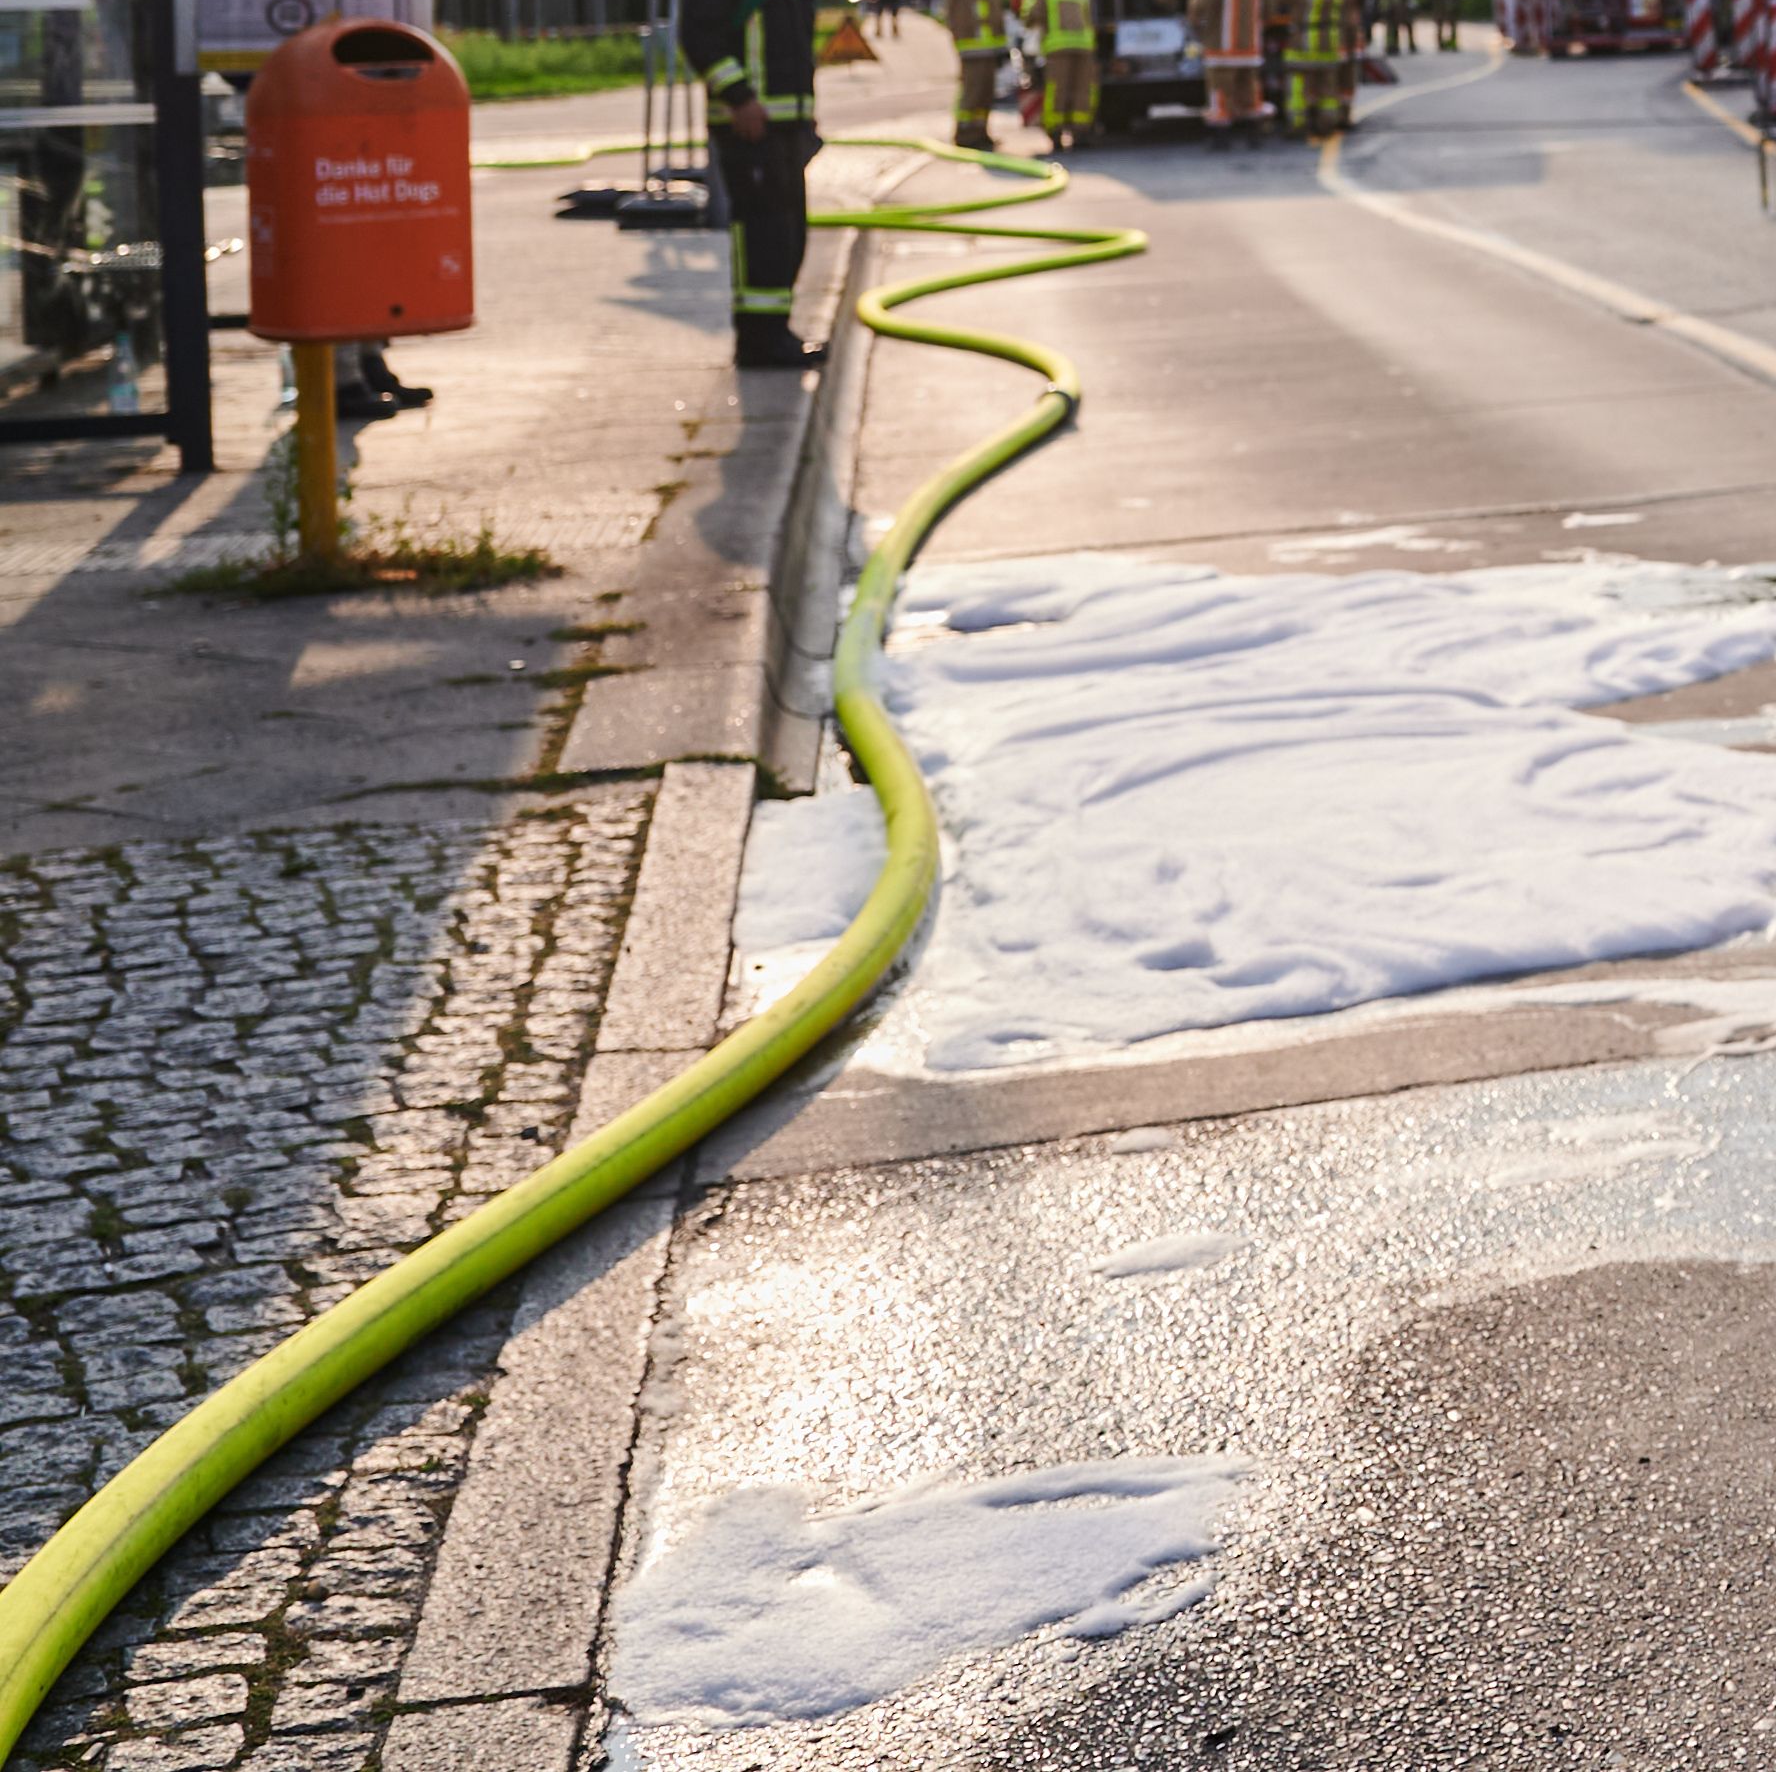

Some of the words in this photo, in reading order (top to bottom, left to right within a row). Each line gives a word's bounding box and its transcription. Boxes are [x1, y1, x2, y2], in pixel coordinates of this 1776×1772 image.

[315, 157, 381, 180] Danke
[386, 155, 415, 176] für
[315, 183, 349, 206] die
[353, 183, 390, 203] Hot
[394, 180, 440, 203] Dogs
